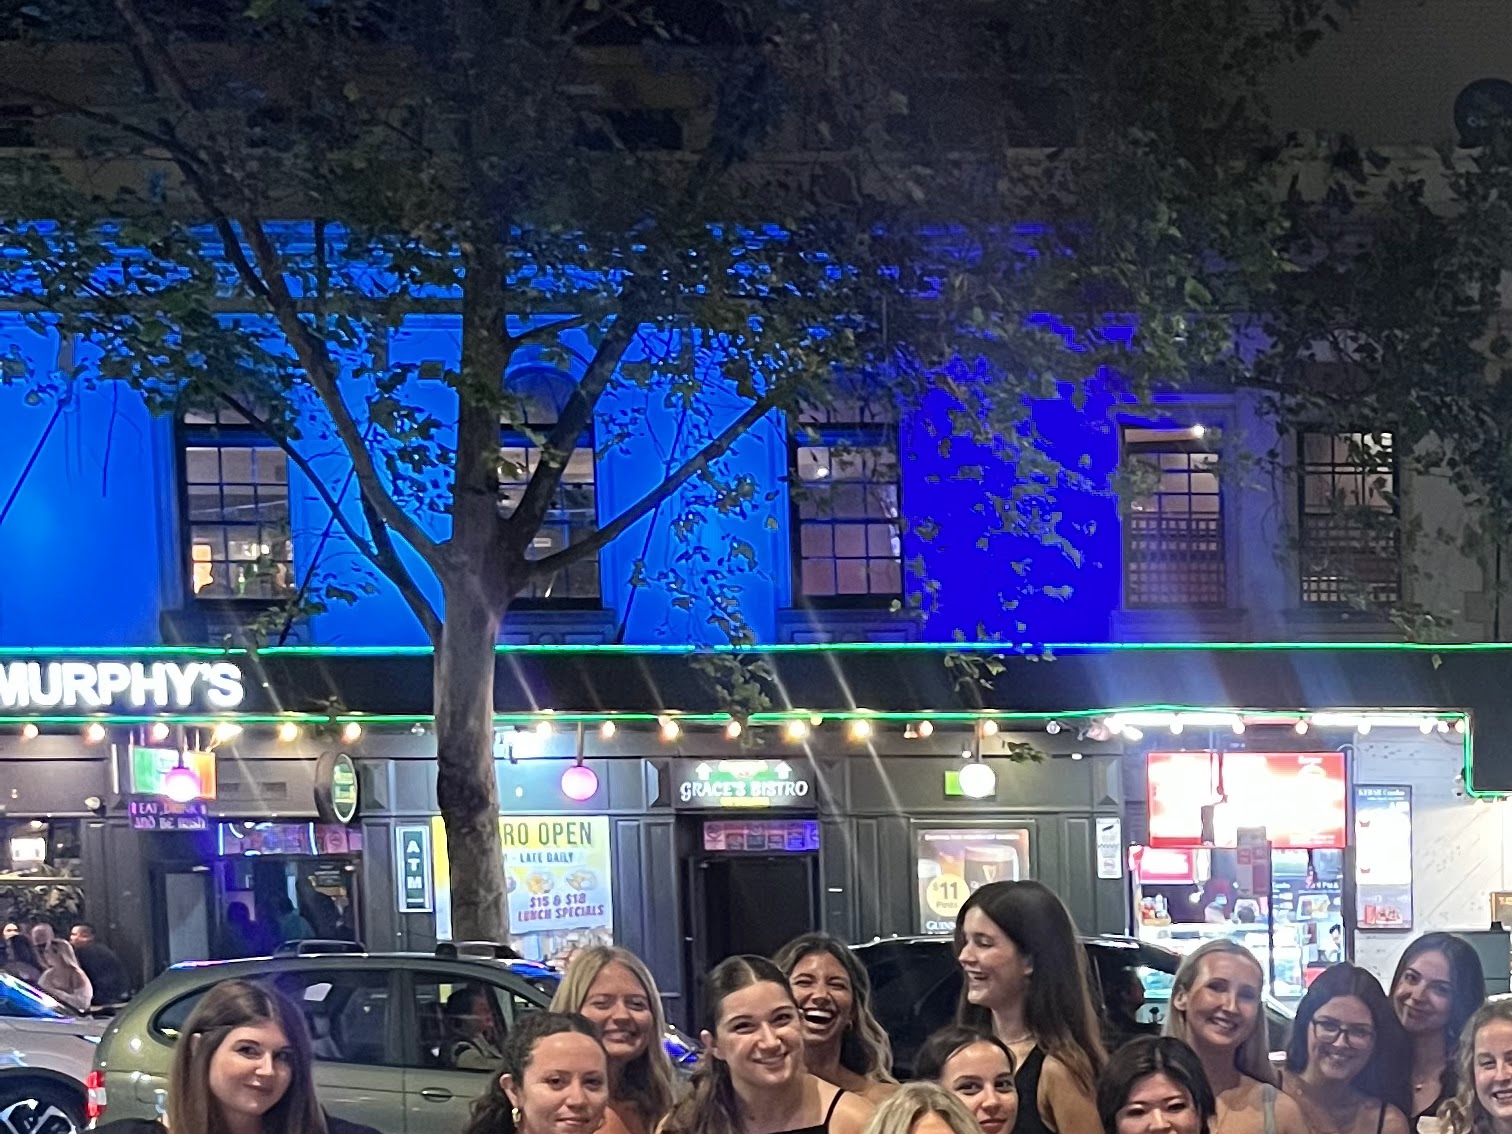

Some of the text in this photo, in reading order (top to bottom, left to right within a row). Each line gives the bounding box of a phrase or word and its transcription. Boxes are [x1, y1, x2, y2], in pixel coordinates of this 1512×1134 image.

[0, 662, 244, 707] MURPHY'S
[679, 781, 747, 802] GRACE'S
[751, 780, 809, 797] BISTRO
[502, 821, 593, 846] RO OPEN
[406, 839, 423, 889] ATM
[520, 853, 543, 864] LATE
[547, 852, 574, 863] DAILY
[518, 904, 605, 922] LUNCH SPECIALS
